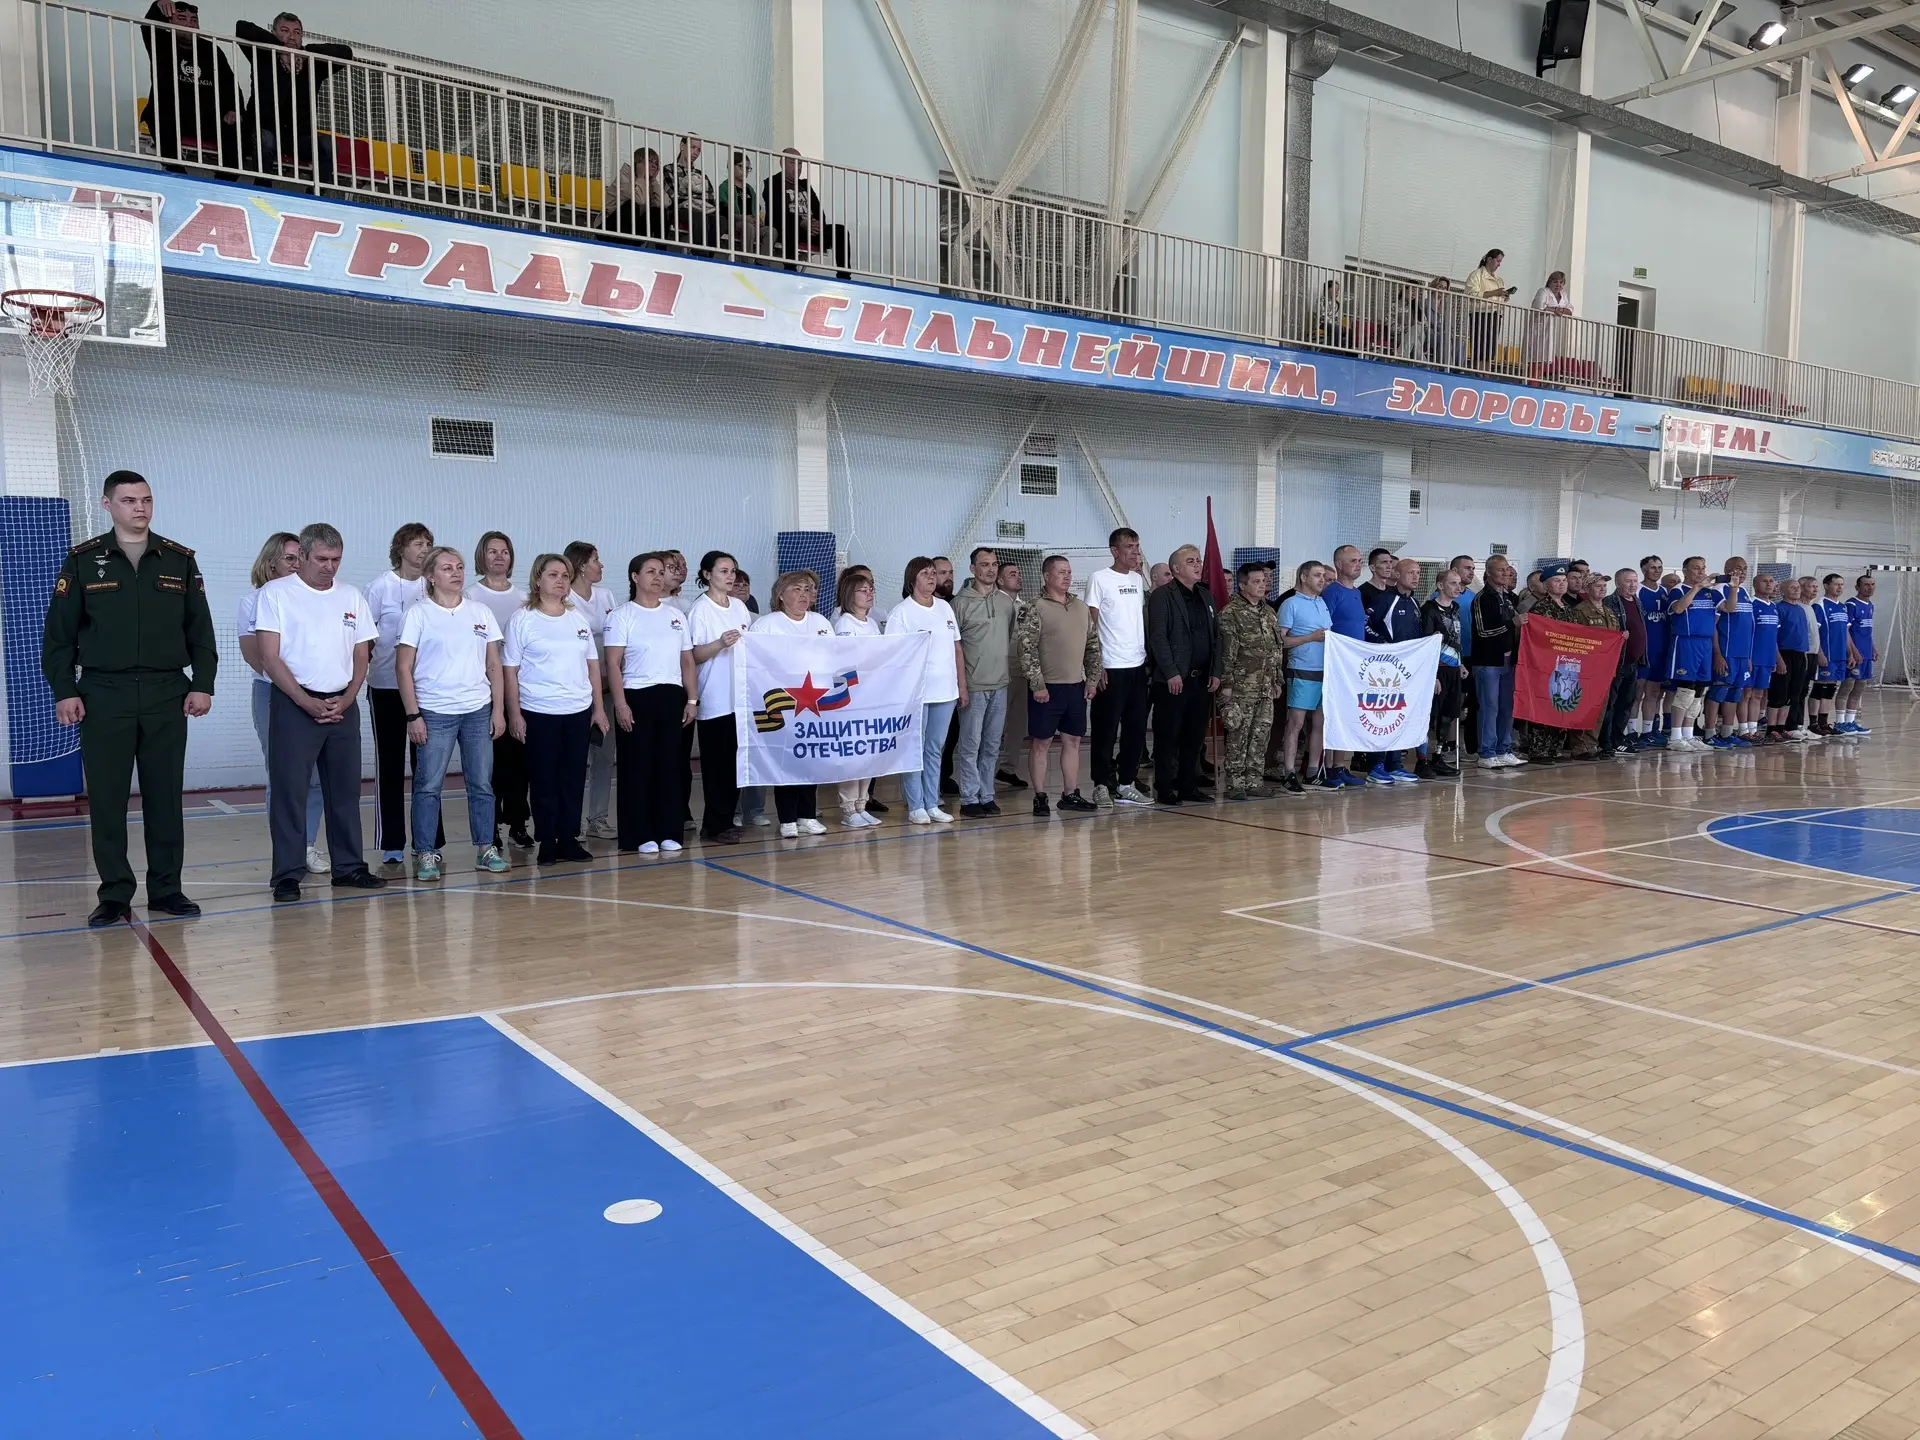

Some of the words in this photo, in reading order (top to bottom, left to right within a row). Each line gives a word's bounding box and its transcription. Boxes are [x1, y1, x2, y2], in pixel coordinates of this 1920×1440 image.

[800, 293, 1338, 406] СИЛЬНЕЙШИМ,
[1385, 377, 1621, 437] ЗДОРОВЬЕ
[1358, 653, 1412, 680] АССОЦИАЦИЯ
[1362, 687, 1400, 709] СВО
[794, 714, 912, 741] ЗАЩИТНИКИ
[1359, 712, 1406, 736] ВЕТЕРАНОВ
[793, 736, 897, 759] ОТЕЧЕСТВА
